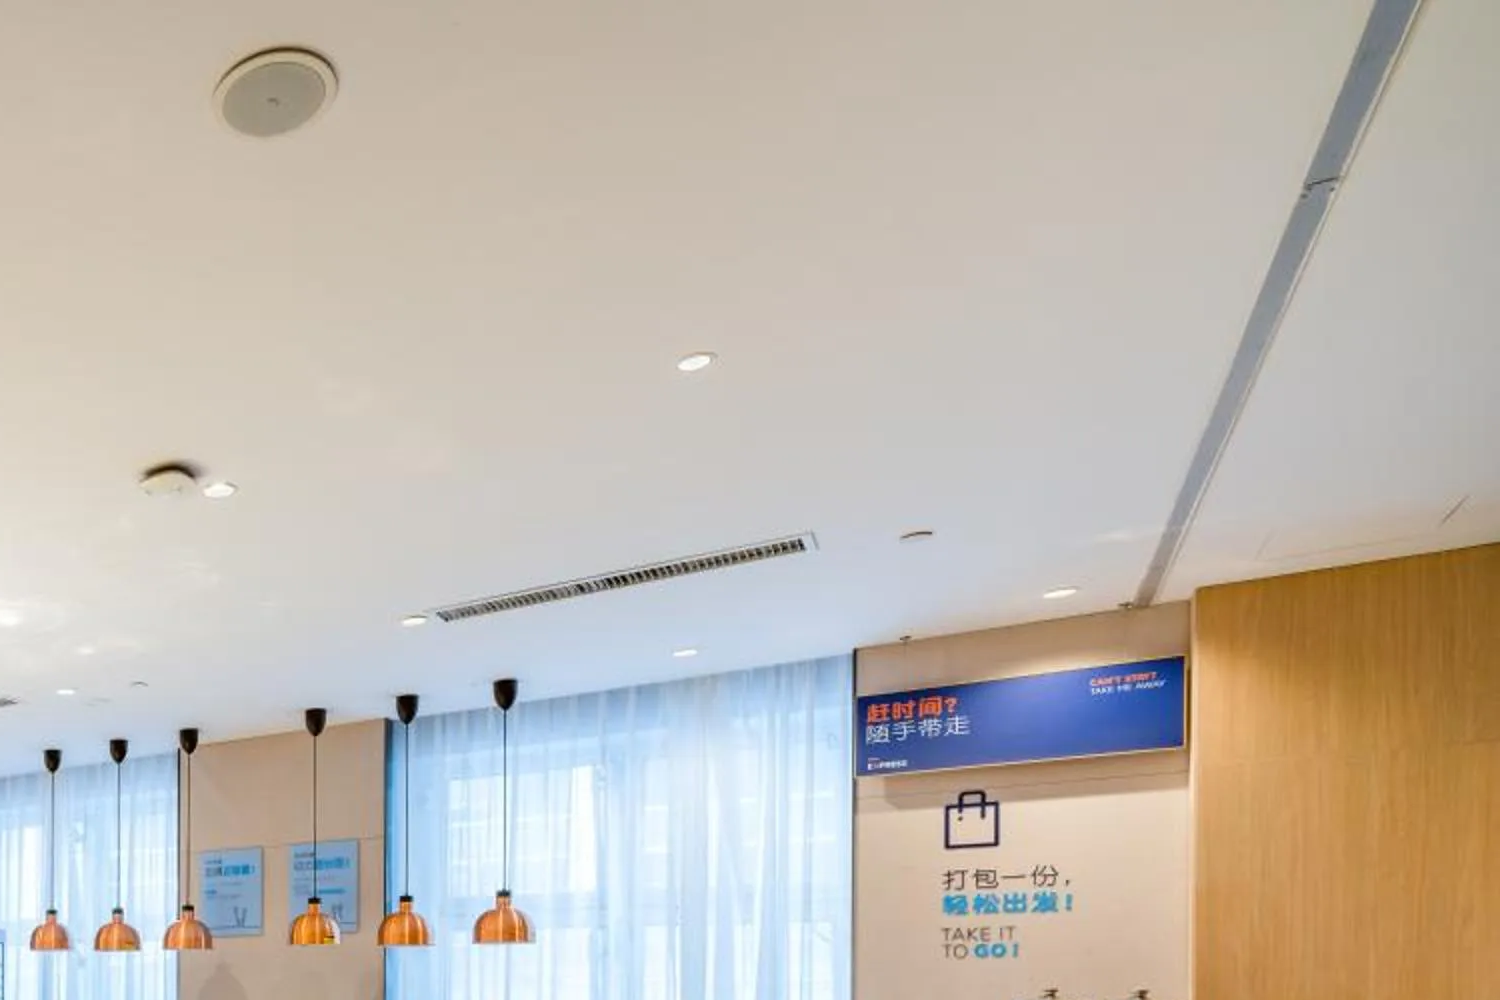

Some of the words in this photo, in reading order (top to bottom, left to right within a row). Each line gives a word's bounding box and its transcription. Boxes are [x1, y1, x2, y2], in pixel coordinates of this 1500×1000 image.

[865, 714, 971, 745] 随手带走
[941, 865, 1071, 891] 打包一份，
[942, 891, 1074, 916] 轻松出发！
[941, 926, 992, 942] TAKE
[999, 924, 1018, 940] IT
[941, 942, 969, 960] TO
